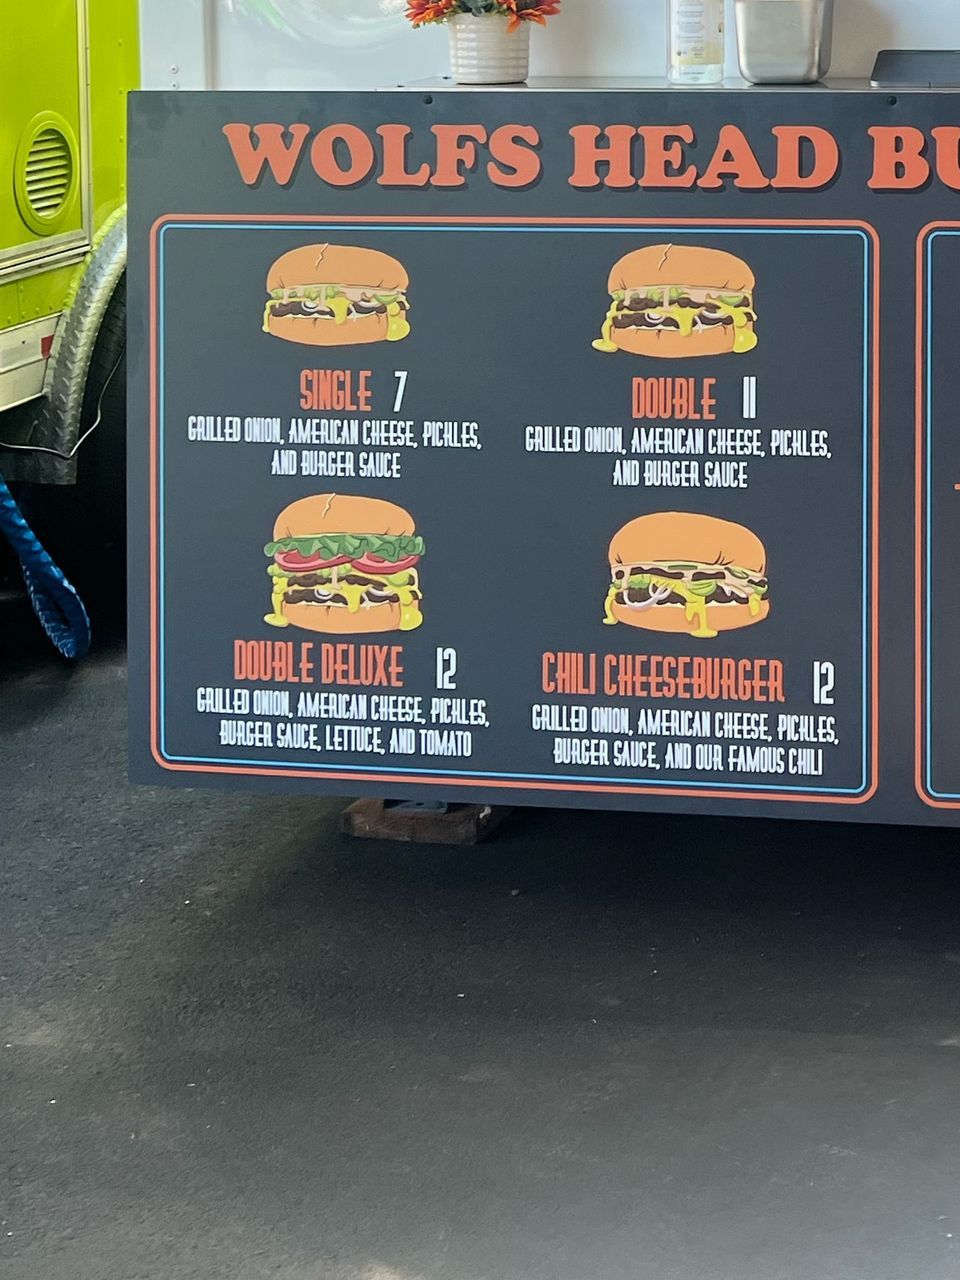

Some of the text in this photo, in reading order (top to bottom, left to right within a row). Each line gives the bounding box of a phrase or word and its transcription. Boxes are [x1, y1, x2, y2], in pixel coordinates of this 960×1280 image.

[224, 124, 540, 186] WOLFS
[570, 125, 838, 188] HEAD
[301, 370, 407, 411] SINGLE 7
[633, 377, 756, 420] DOUBLE 11
[188, 416, 481, 449] GRILLED ONION, AMERICAN CHEESE, PICKLES,
[526, 426, 831, 458] GRILLED ONION, AMERICAN CHEESE, PICKLES,
[272, 450, 400, 477] AND BURGER SAUCE
[613, 460, 747, 487] AND BURGER SAUCE
[235, 640, 456, 689] DOUBLE DELUXE 12
[544, 652, 834, 704] CHILI CHEESEBURGER 12
[197, 687, 489, 727] GRILLED ONION, AMERICAN CHEESE, PICKLES,
[533, 705, 838, 744] GRILLED ONION, AMERICAN CHEESE, PICKLES,
[220, 720, 471, 756] BURGER SAUCE, LETTUCE, AND TOMATO
[553, 738, 822, 775] BURGER SAUCE, AND OUR FAMOUS CHILI
